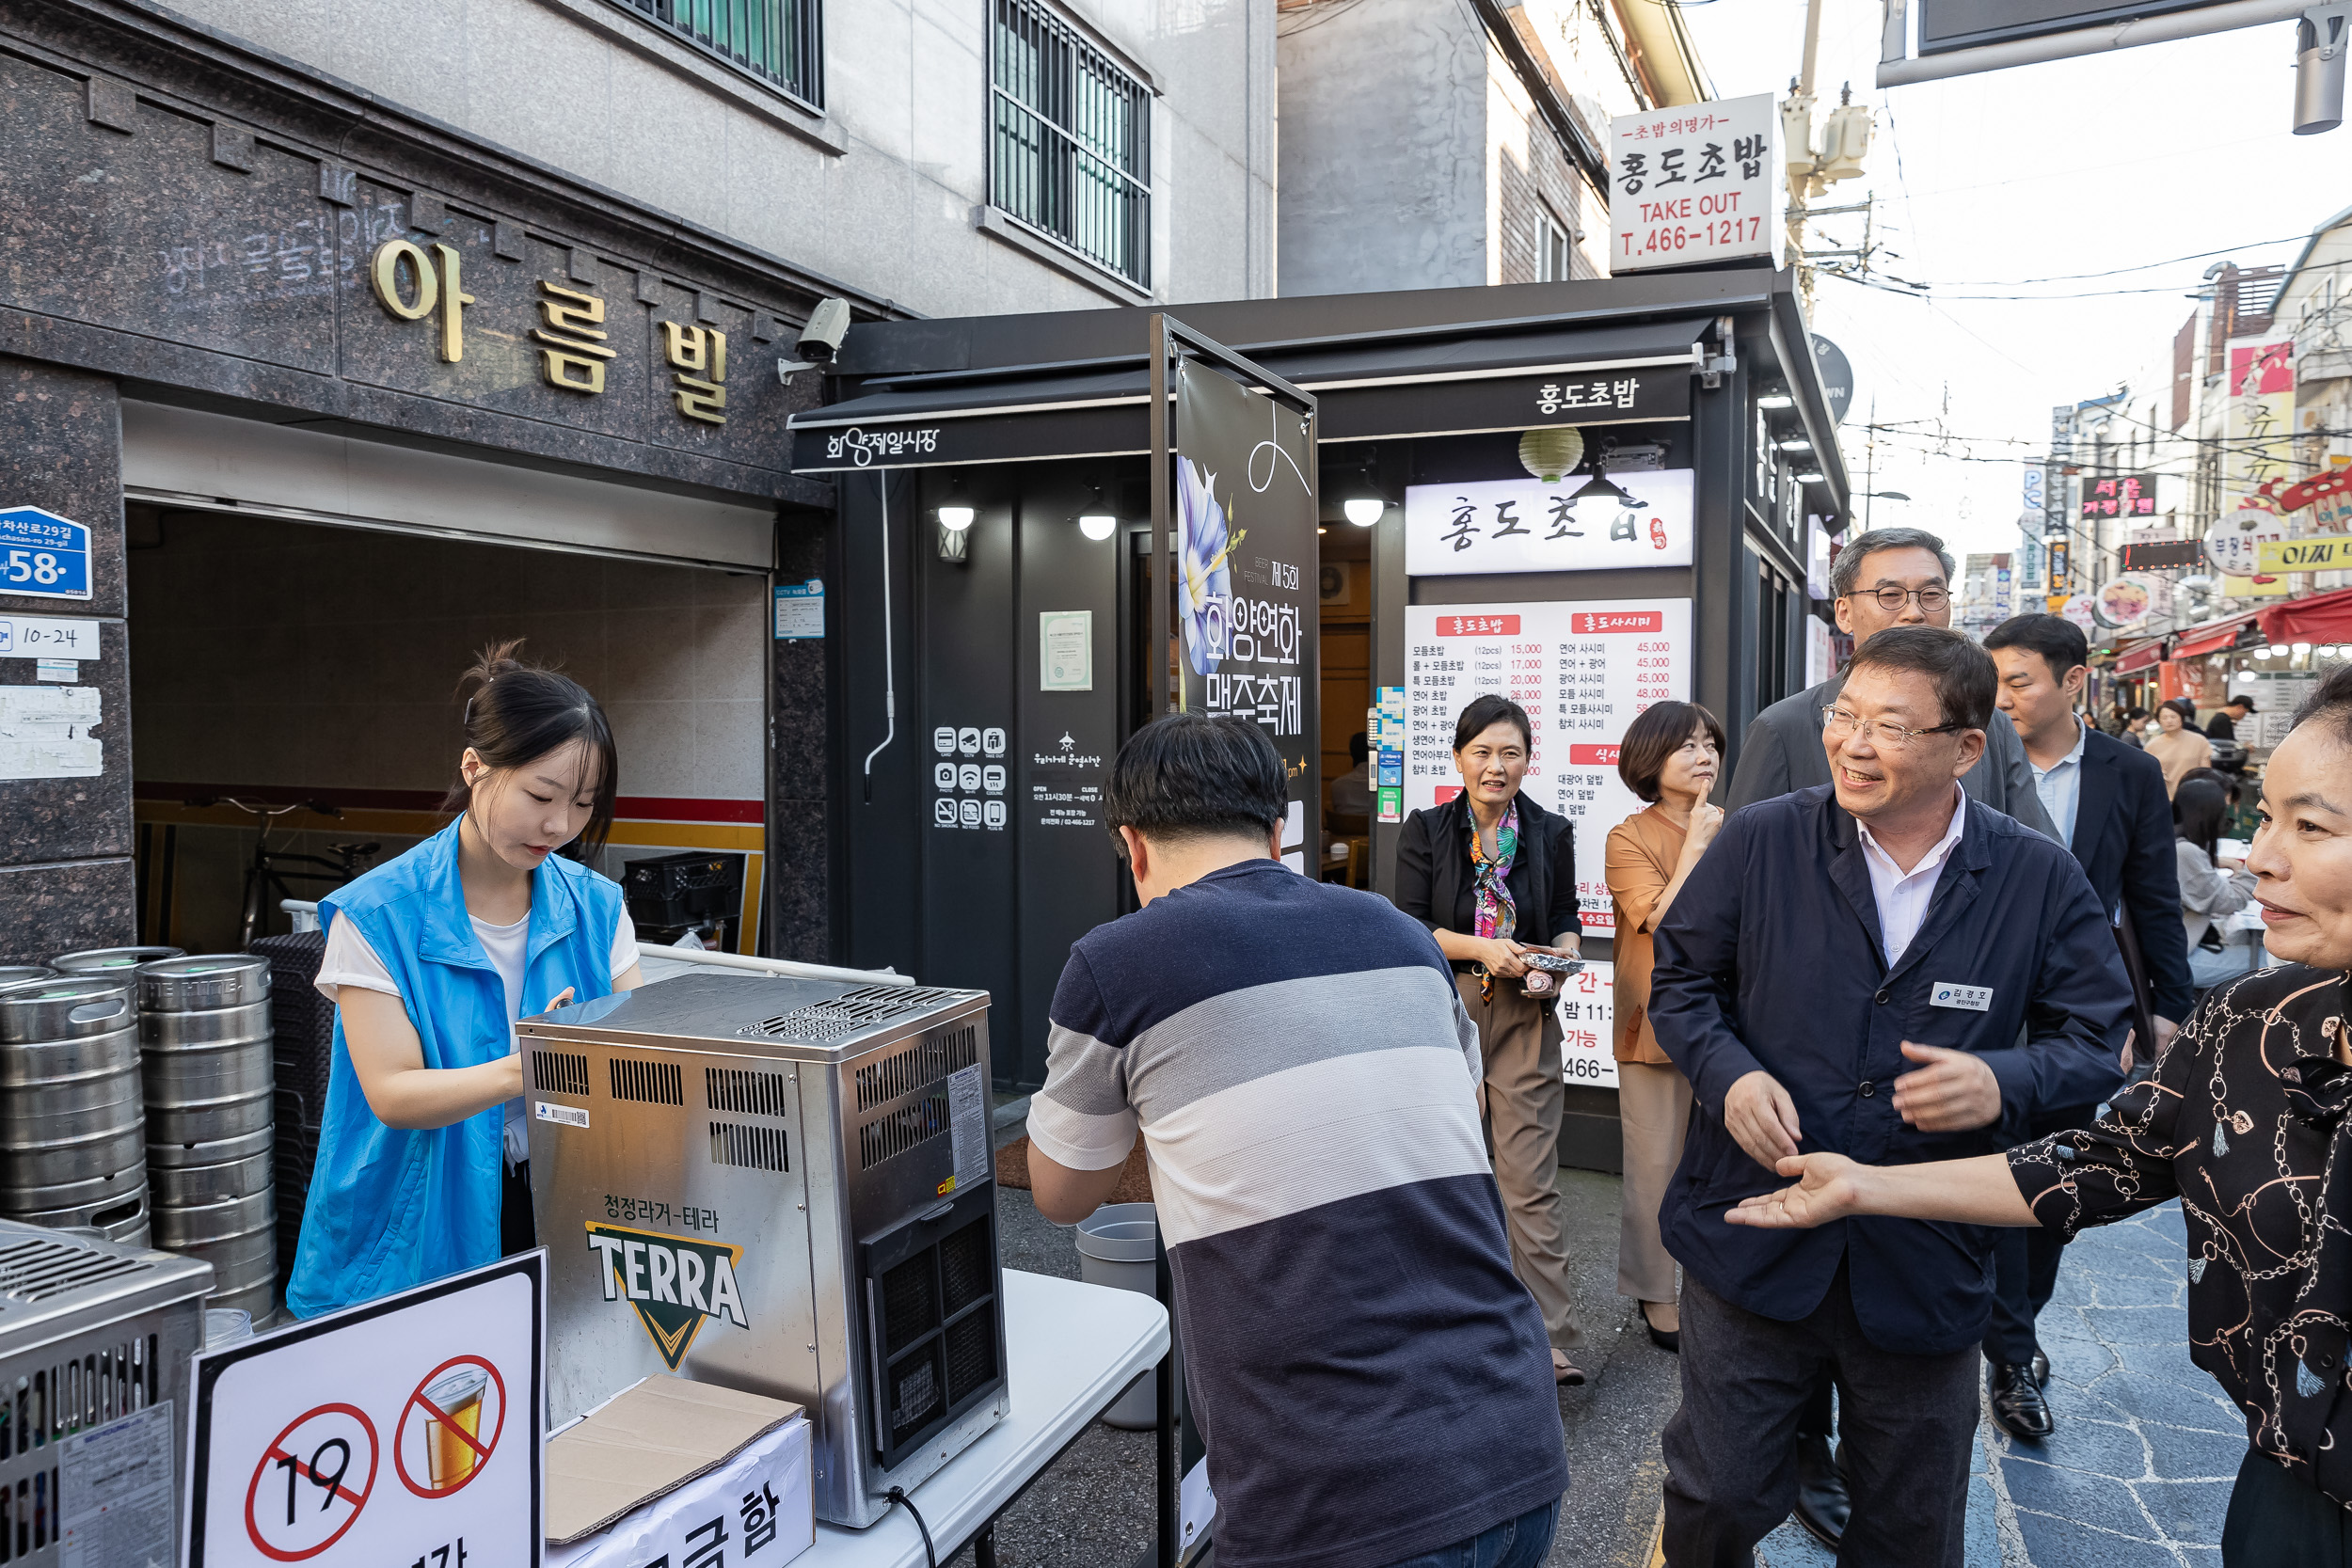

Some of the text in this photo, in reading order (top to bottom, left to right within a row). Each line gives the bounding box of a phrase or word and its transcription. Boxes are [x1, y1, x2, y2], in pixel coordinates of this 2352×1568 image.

[1616, 134, 1768, 196] 홍도초밥
[1639, 191, 1742, 223] TAKE OUT
[1620, 216, 1760, 256] T.466-1217
[1535, 377, 1641, 415] 홍도초밥
[1825, 387, 1845, 398] WN
[826, 427, 941, 467] 화양제일시장
[0, 519, 72, 540] 차산로29길
[8, 549, 58, 585] 58
[1254, 556, 1269, 570] BEER
[1244, 570, 1270, 586] FESTIVAL
[1204, 590, 1303, 665] 화양연화
[1453, 616, 1503, 635] 홍도초밥
[1583, 612, 1651, 633] 홍도사시미
[23, 626, 78, 648] 10-24
[1412, 643, 1542, 657] 모듬초밥 (12pcs) 15,000
[1559, 641, 1670, 655] 연어 사시미 45,000
[1432, 660, 1465, 672] 모듬초밥
[1474, 660, 1502, 672] (12pcs)
[1511, 659, 1542, 671] 17,000
[1559, 658, 1576, 670] 연어
[1588, 658, 1606, 670] 광어
[1636, 657, 1670, 668] 45,000
[1423, 675, 1455, 687] 모듬초밥
[1474, 675, 1502, 687] (12pcs)
[1510, 674, 1542, 686] 20,000
[1559, 673, 1670, 685] 광어 사시미 45,000
[1412, 690, 1428, 702] 연어
[1431, 690, 1448, 702] 초밥
[1559, 688, 1670, 700] 모듬 사시미 48,000
[1431, 705, 1447, 716] 초밥
[1570, 704, 1613, 715] 모듬사시미
[1412, 721, 1428, 732] 연어
[1558, 719, 1604, 730] 참치 사시미
[1412, 735, 1436, 746] 생연어
[1068, 752, 1102, 768] 운영시간
[1412, 750, 1452, 761] 연어아부리
[1412, 765, 1447, 776] 참치 초밥
[1558, 774, 1583, 785] 대광어
[1558, 789, 1574, 800] 연어
[1577, 897, 1599, 910] 차권
[1564, 1001, 1613, 1021] 밤 11:
[1566, 1029, 1597, 1048] 가능
[1564, 1057, 1614, 1079] 466-
[603, 1194, 721, 1234] 청정라거-테라
[587, 1232, 750, 1331] TERRA
[277, 1437, 351, 1527] 19
[644, 1479, 781, 1568] 금함
